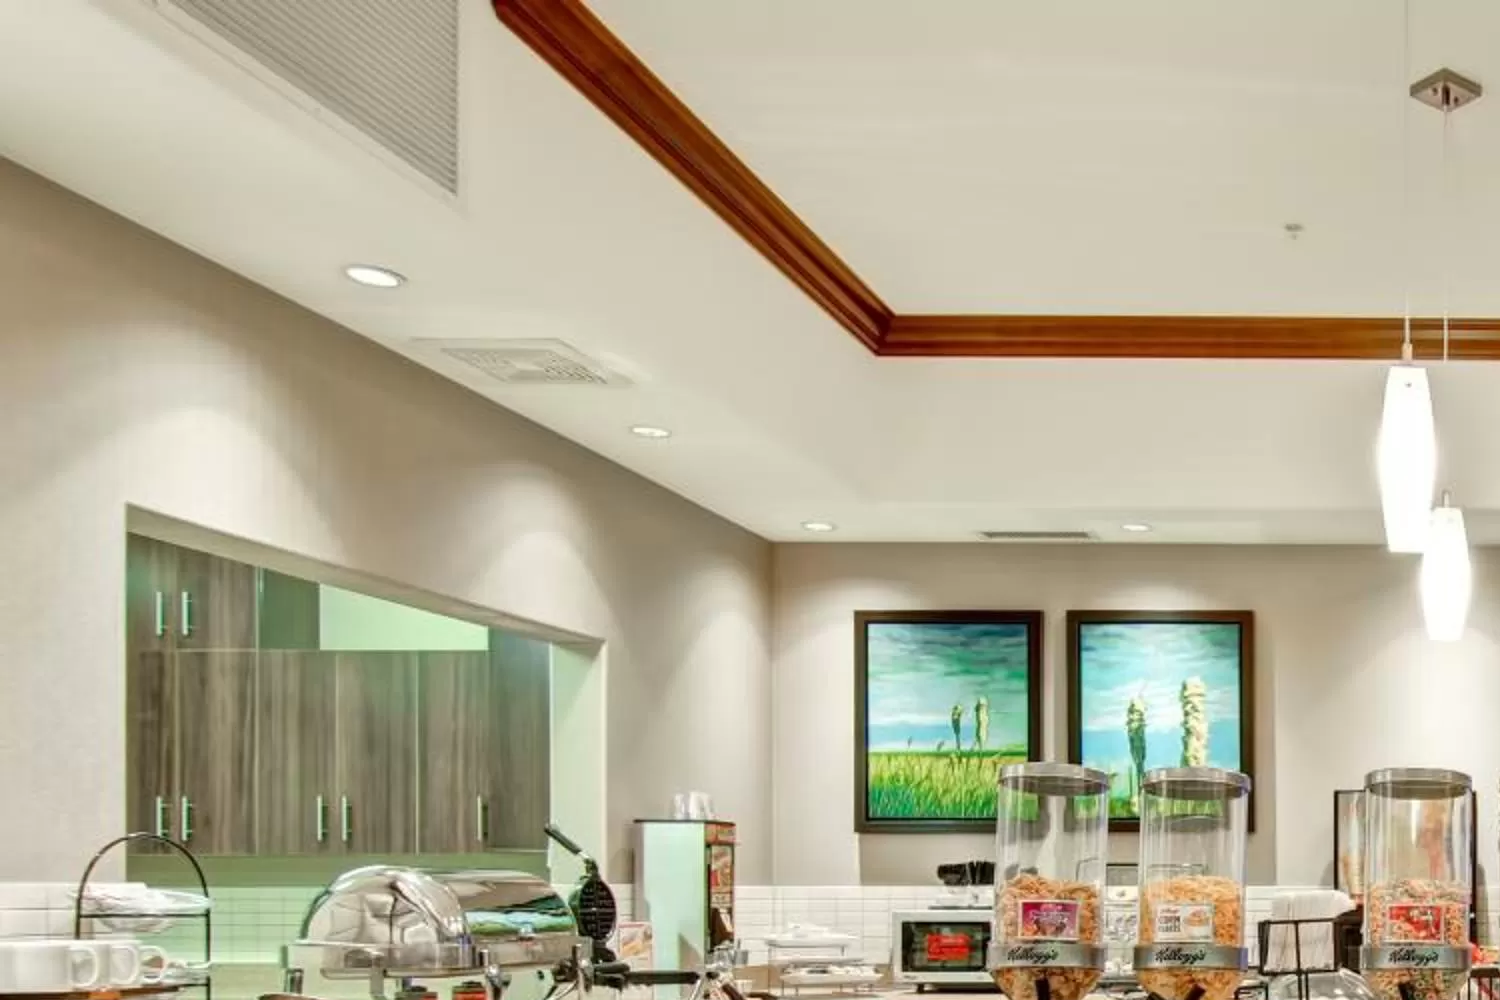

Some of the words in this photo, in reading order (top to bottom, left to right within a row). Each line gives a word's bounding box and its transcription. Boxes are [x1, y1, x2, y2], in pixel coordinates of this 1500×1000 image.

[1007, 945, 1058, 965] Kellogg's
[1155, 947, 1206, 965] Kellogg's
[1389, 947, 1439, 966] Kellogg's
